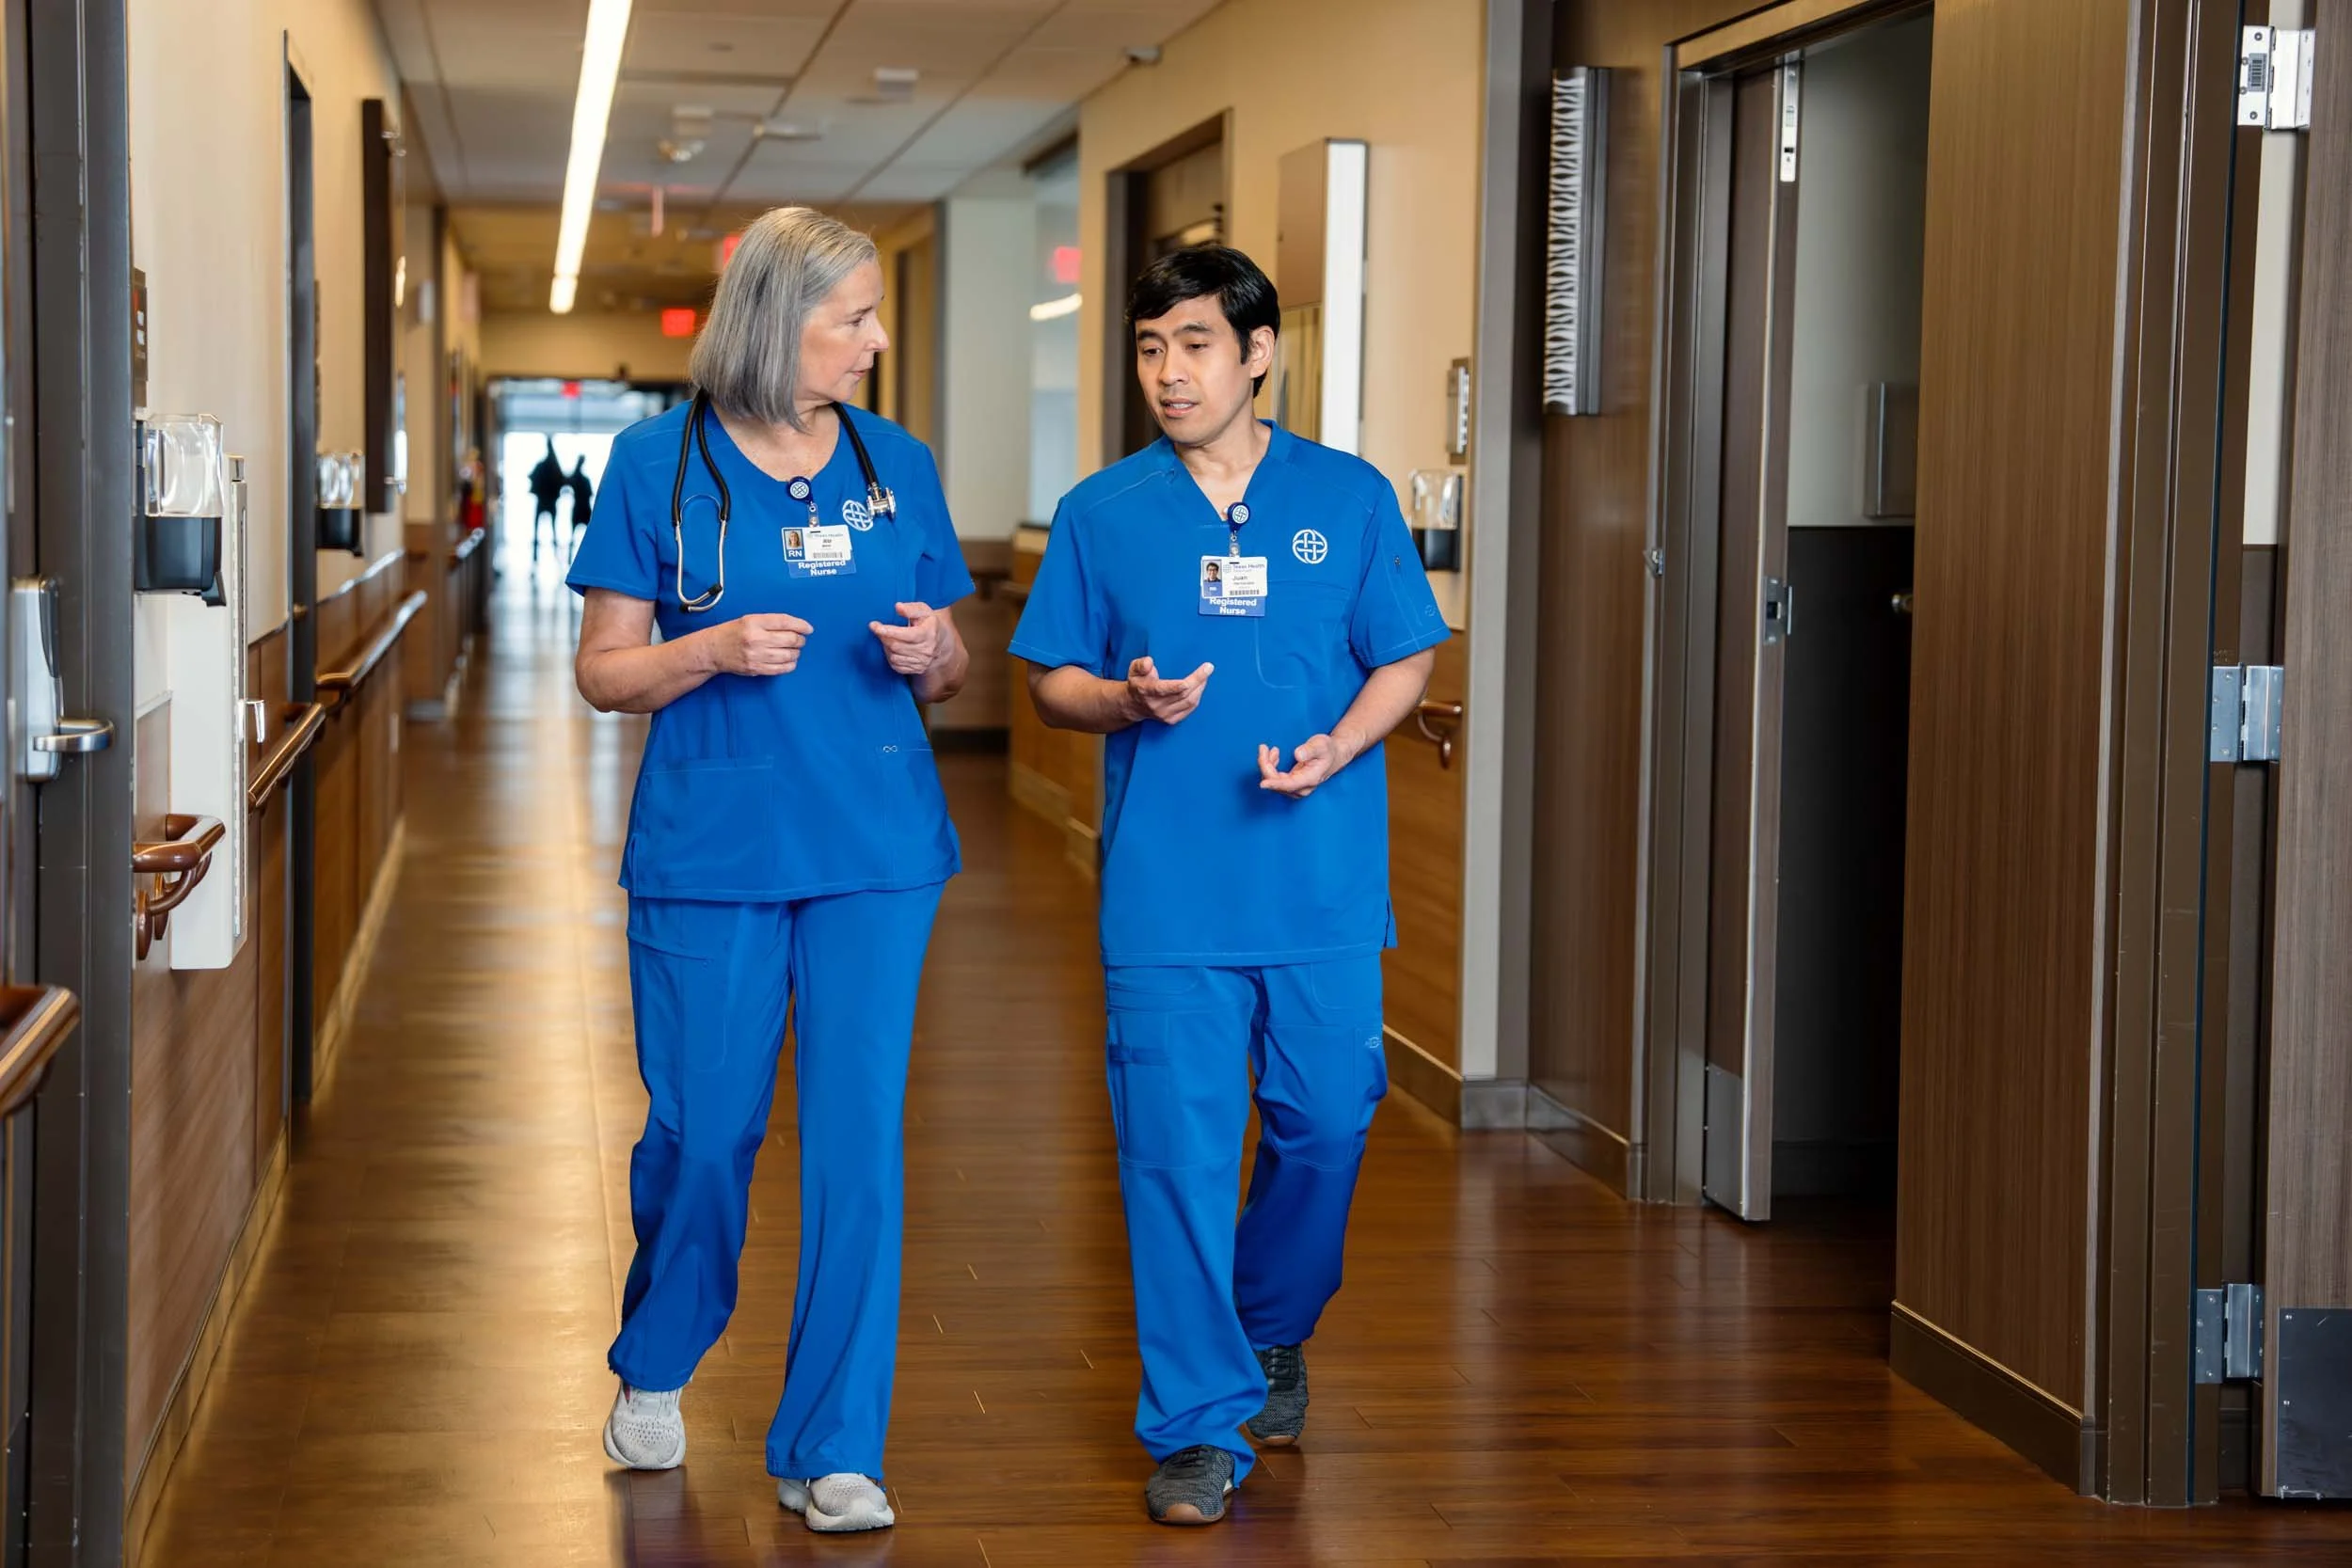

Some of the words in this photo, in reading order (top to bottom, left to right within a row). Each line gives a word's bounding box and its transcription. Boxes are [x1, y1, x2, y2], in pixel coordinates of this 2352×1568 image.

[798, 560, 846, 569] Registered
[810, 568, 837, 577] Nurse
[1209, 597, 1257, 607] Registered
[1219, 606, 1247, 614] Nurse
